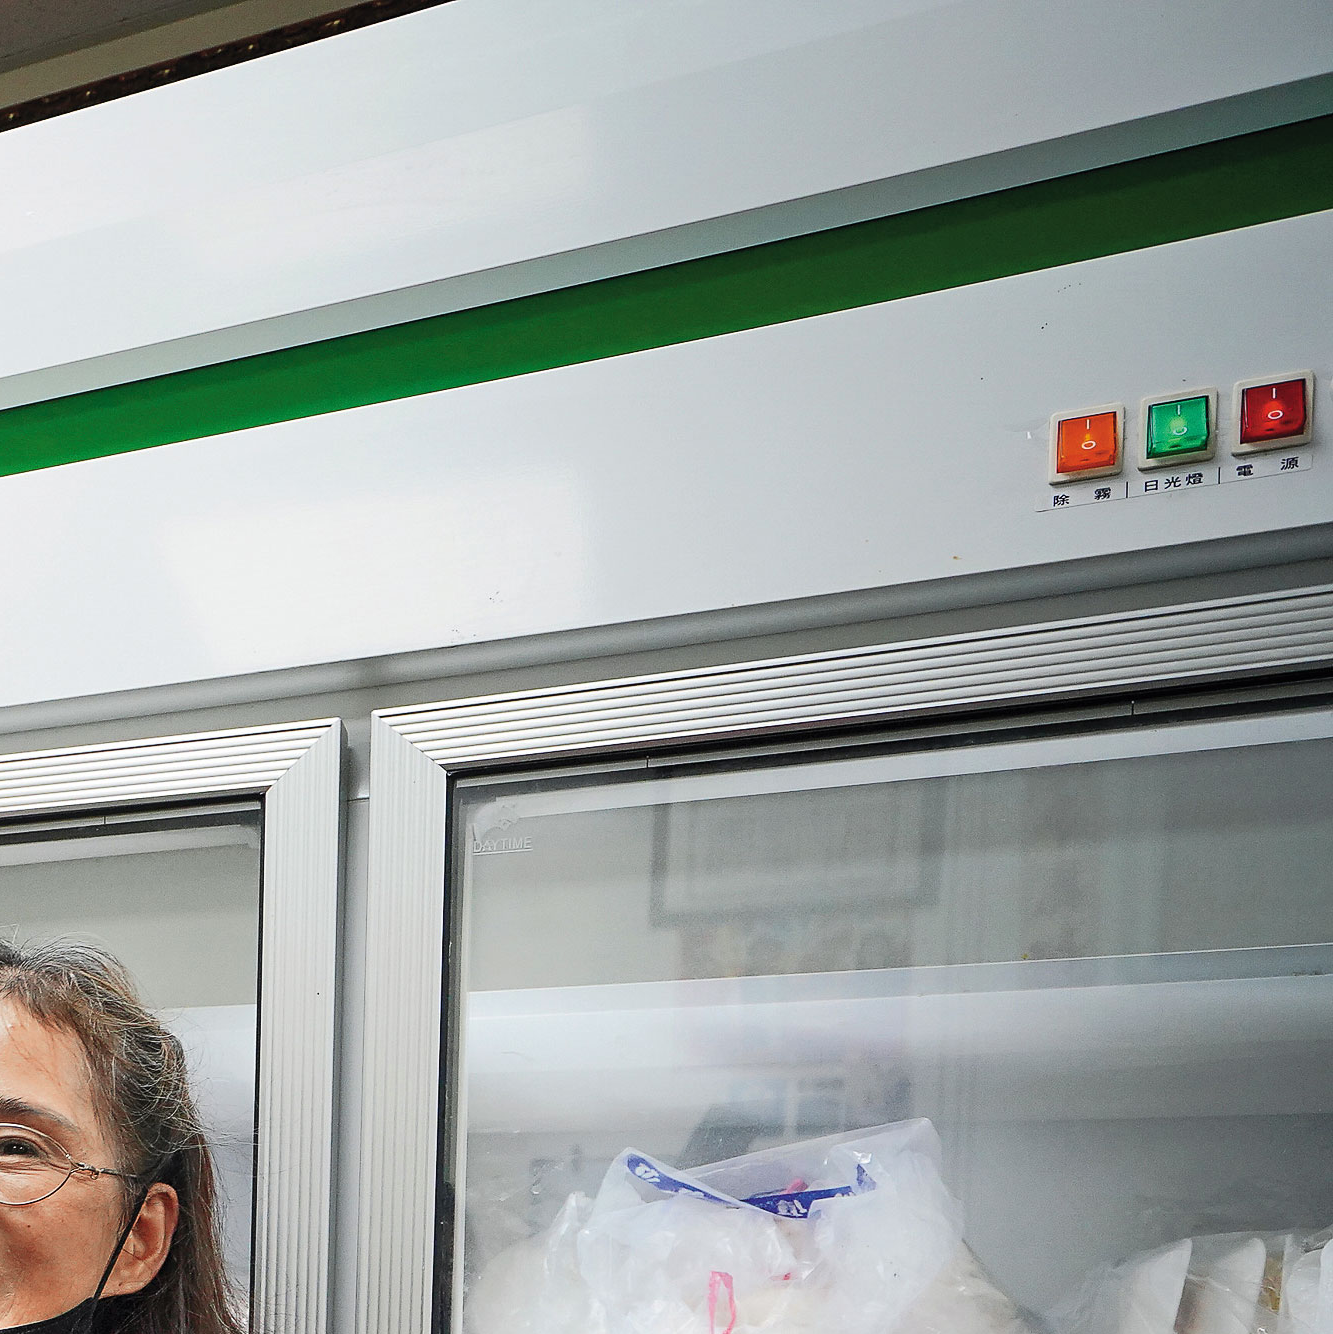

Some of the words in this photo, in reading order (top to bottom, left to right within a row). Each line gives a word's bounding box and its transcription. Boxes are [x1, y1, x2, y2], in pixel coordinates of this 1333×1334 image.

[1236, 456, 1299, 477] 電源
[1144, 472, 1204, 493] 日光燈
[1053, 487, 1111, 507] 除霧
[473, 836, 532, 852] DAYTIME
